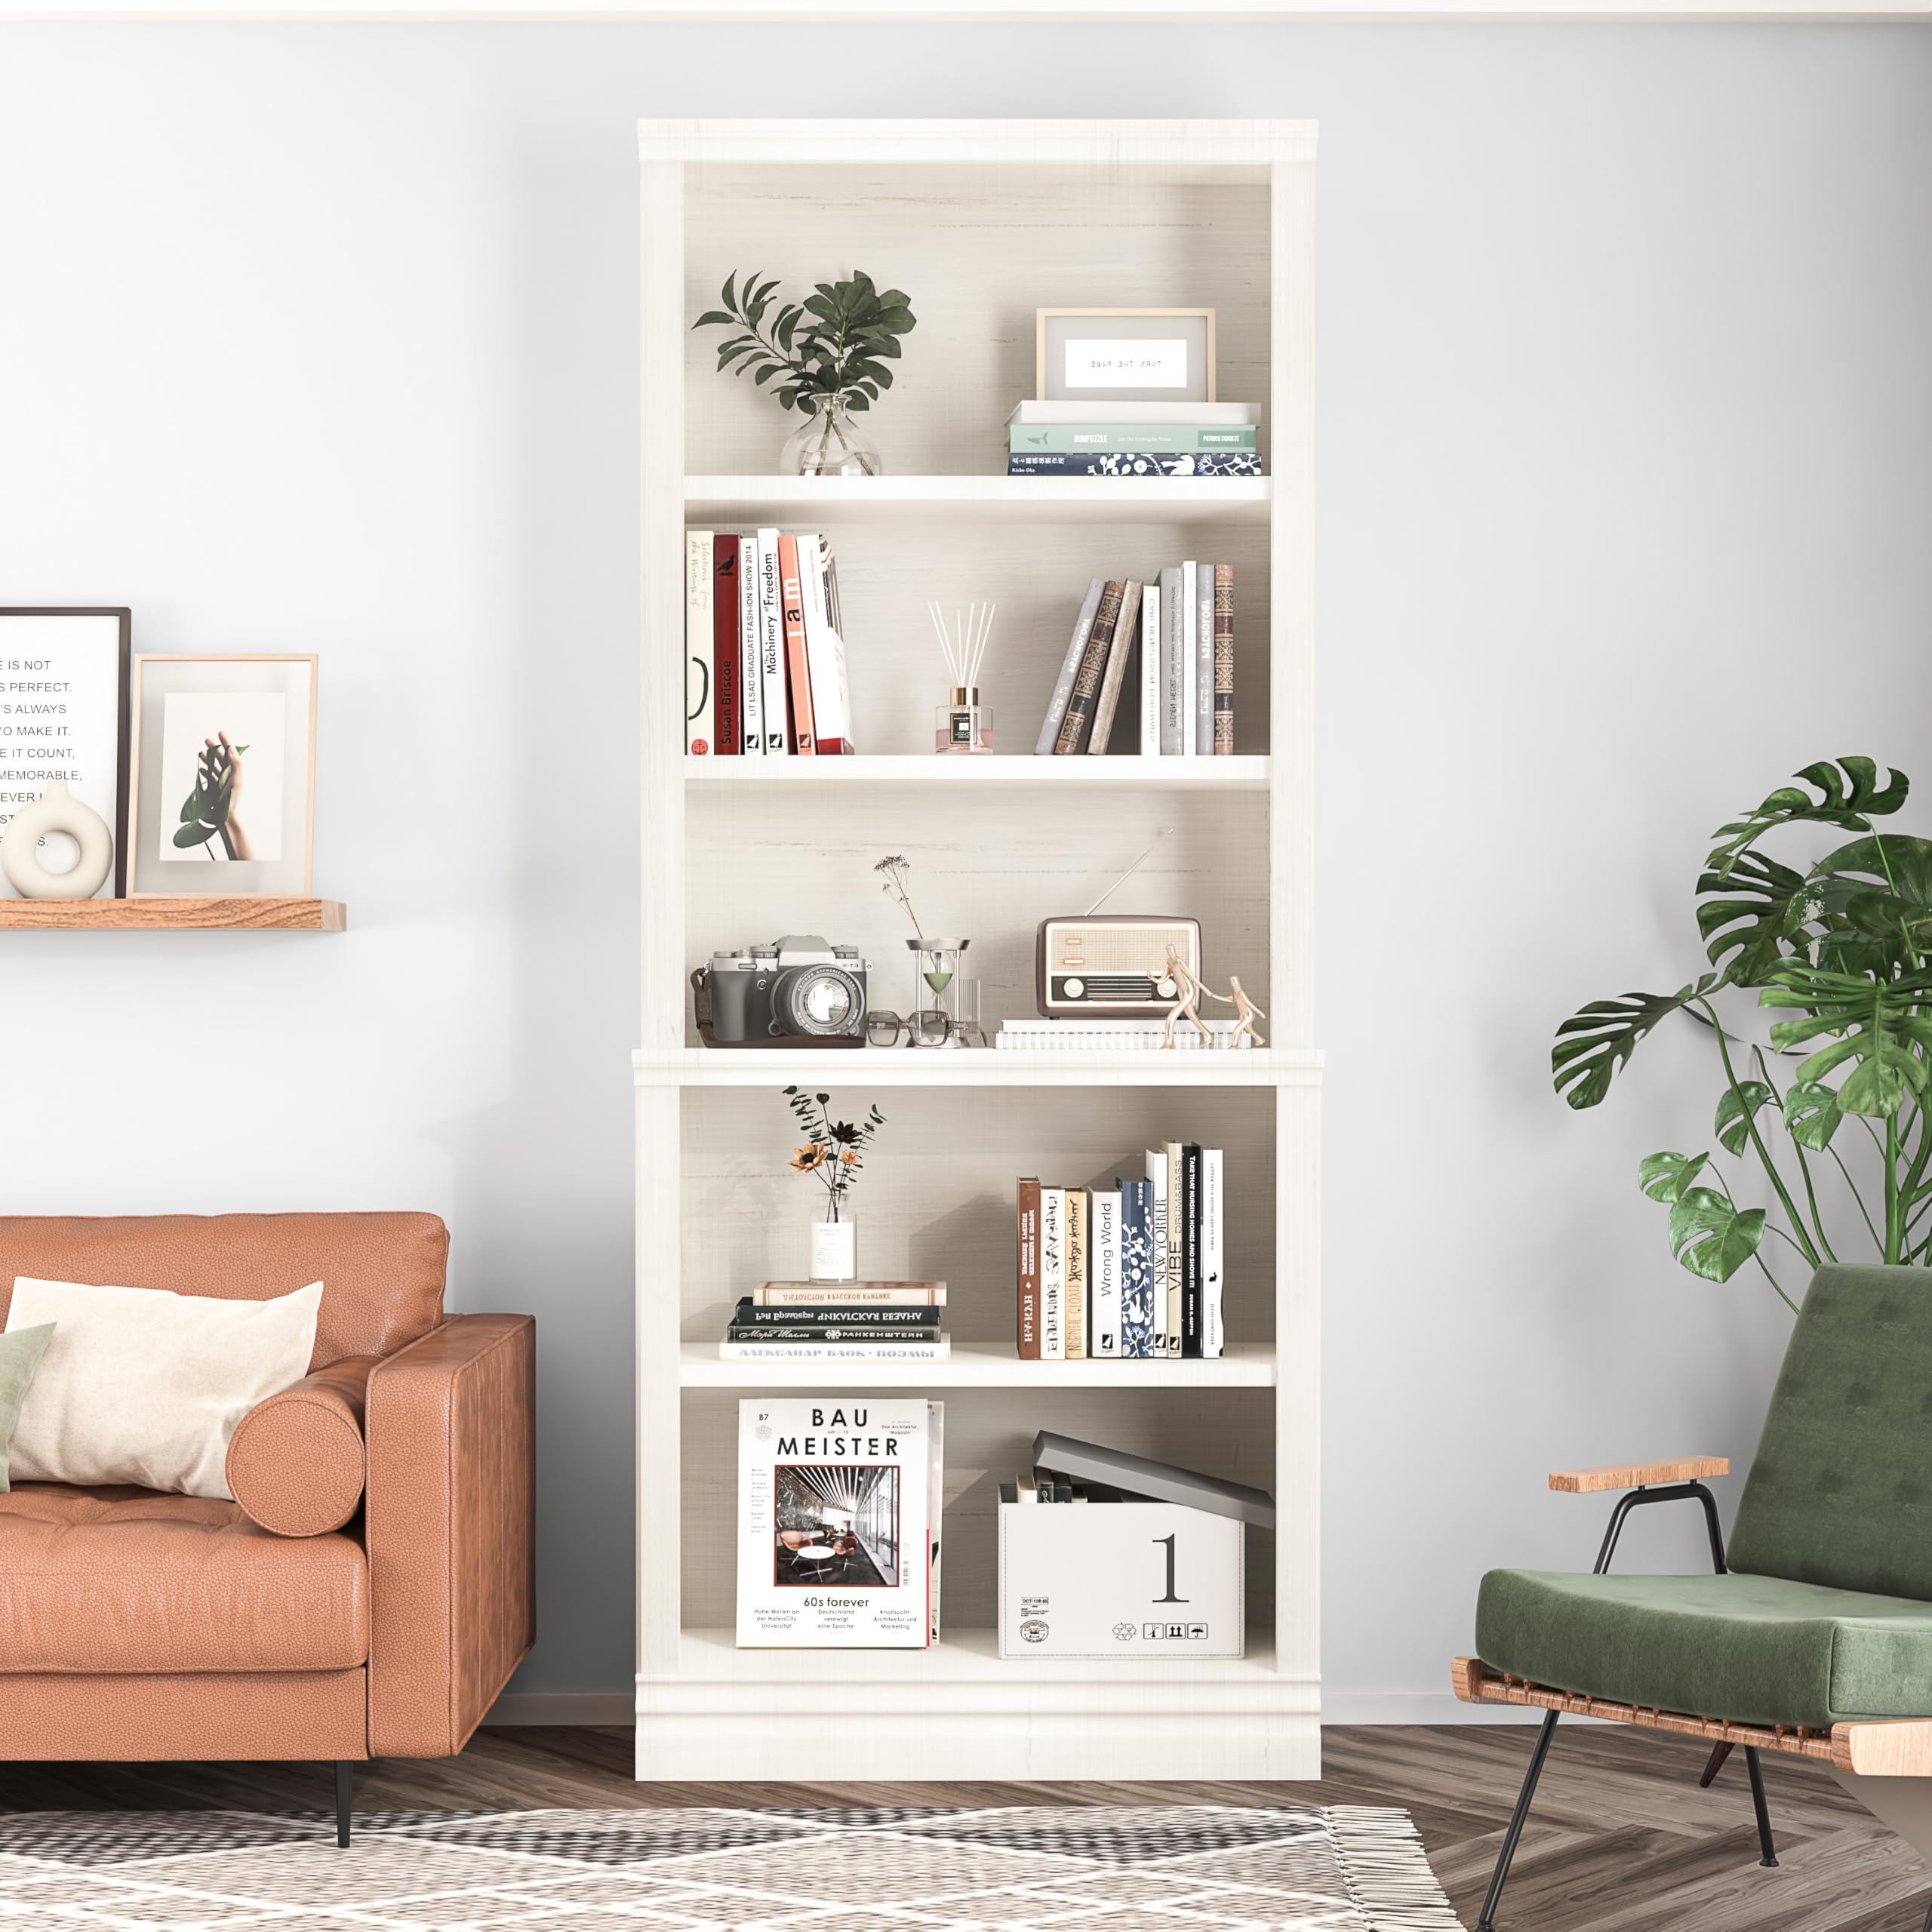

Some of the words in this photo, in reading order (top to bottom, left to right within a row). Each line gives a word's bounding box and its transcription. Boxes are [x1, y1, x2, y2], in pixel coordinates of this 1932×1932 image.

[1074, 435, 1108, 443] BUMFUZZLE
[745, 546, 753, 564] 2014
[762, 553, 775, 605] Freedom
[746, 592, 754, 632] FASH-ION
[766, 616, 778, 674] Machinery
[8, 660, 20, 670] IS
[24, 660, 51, 670] NOT
[747, 633, 755, 678] GRADUATE
[10, 682, 72, 692] PERFECT.
[721, 660, 731, 705] Briscoe
[15, 704, 66, 714] ALWAYS
[17, 726, 53, 736] MAKE
[57, 726, 71, 736] IT.
[721, 709, 731, 744] Susan
[12, 749, 23, 758] IT
[27, 748, 75, 759] COUNT,
[816, 968, 847, 979] ASPHERICAL
[1101, 1203, 1112, 1244] World
[1101, 1250, 1113, 1297] Wrong
[1169, 1241, 1181, 1291] VIBE
[738, 1349, 822, 1357] АЛЕКСАНДР
[876, 1349, 934, 1358] ПОЭМЫ
[812, 1408, 868, 1427] BAU
[777, 1437, 898, 1456] MEISTER
[1152, 1533, 1190, 1603] 1
[804, 1597, 823, 1607] 60s
[827, 1596, 869, 1607] forever
